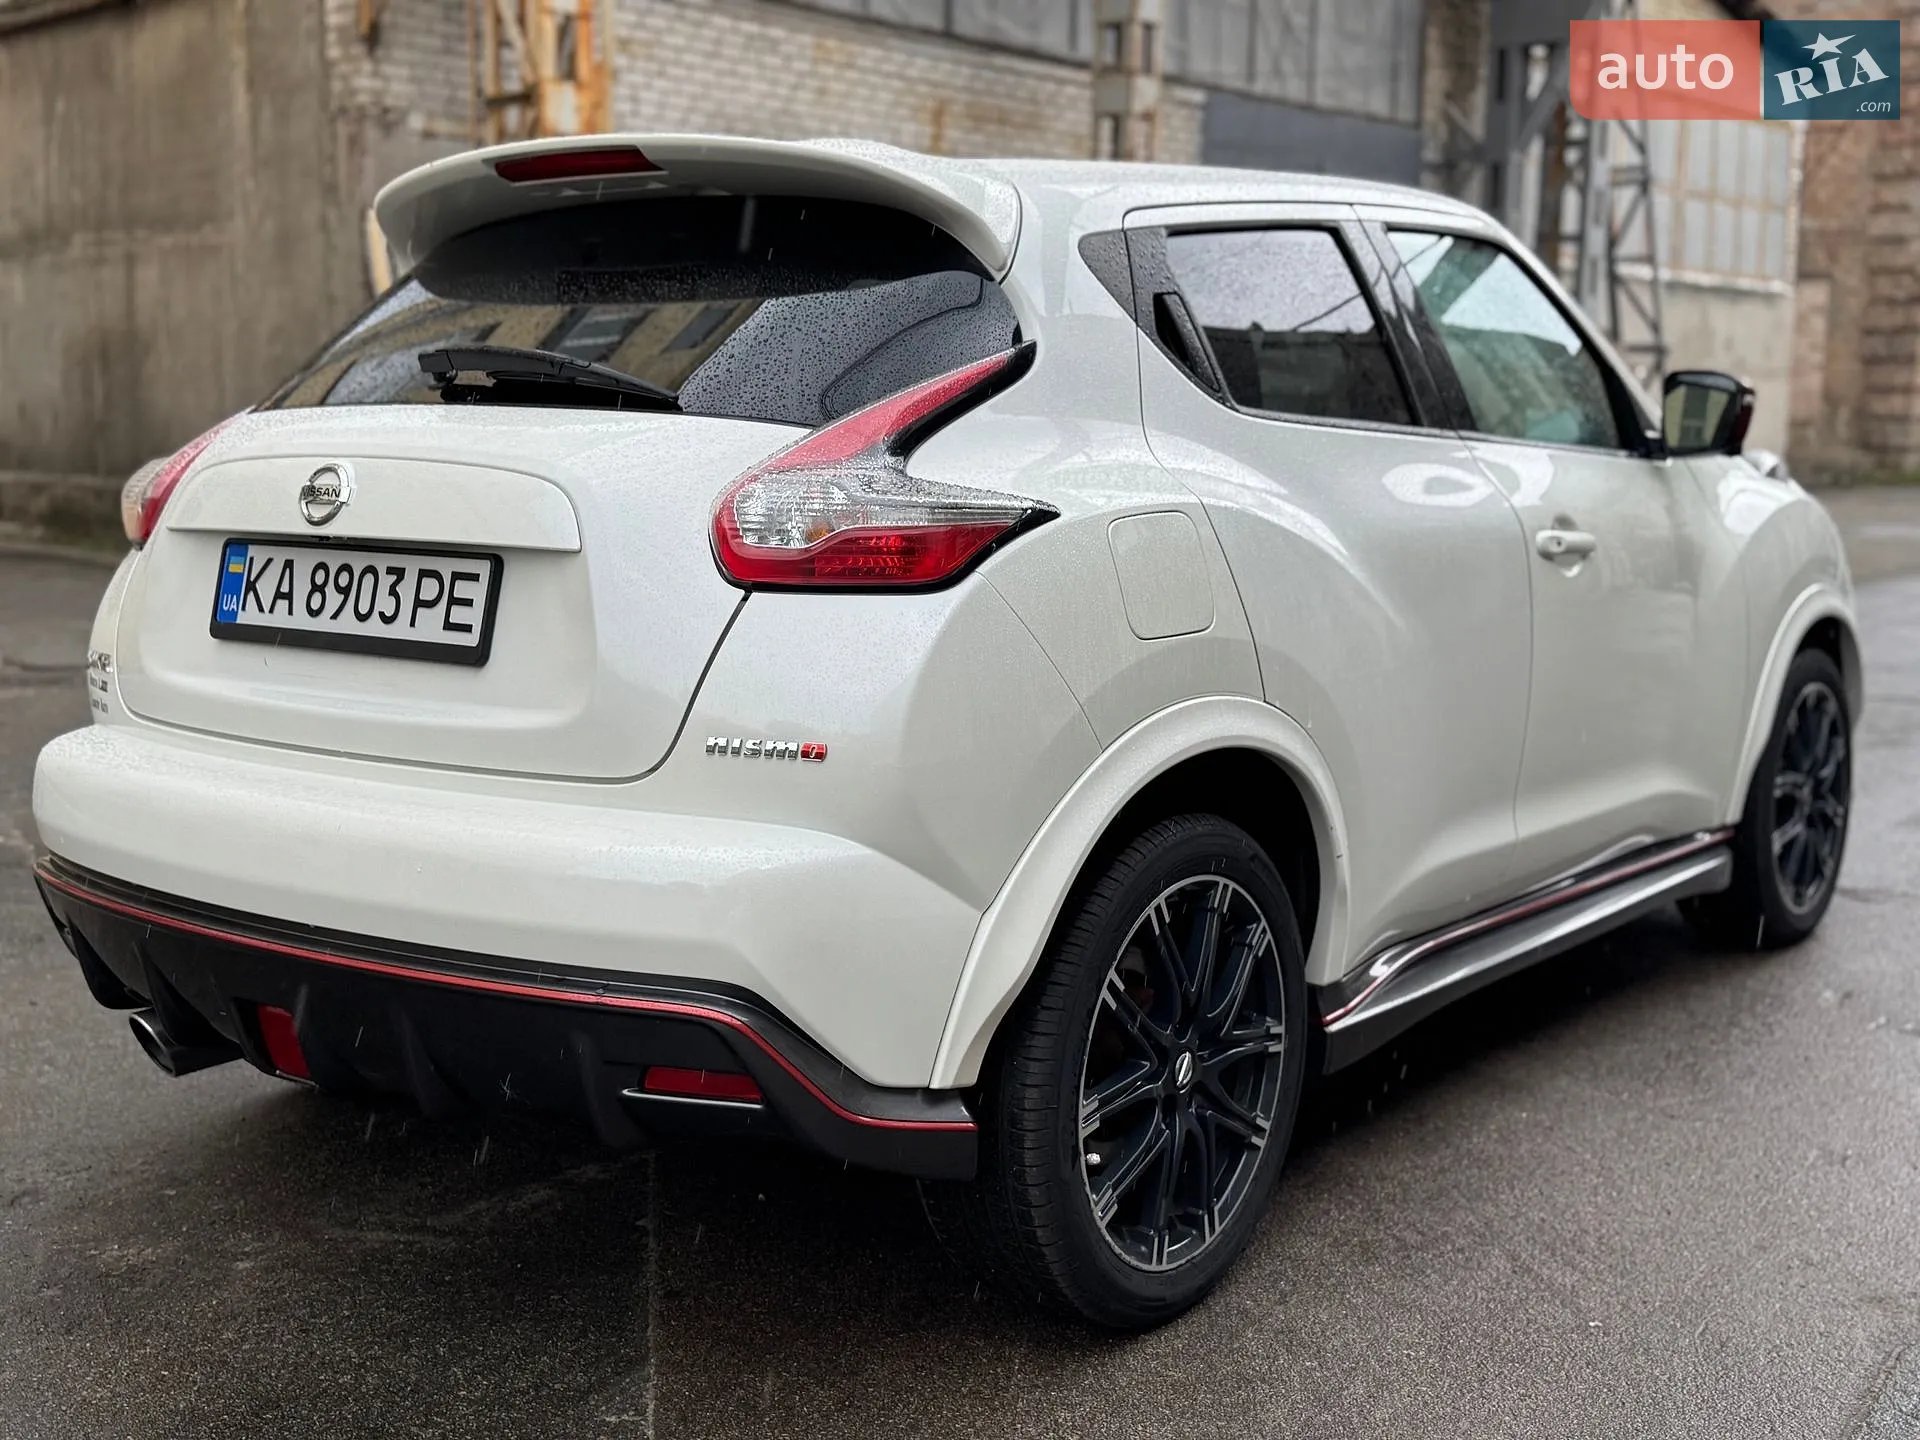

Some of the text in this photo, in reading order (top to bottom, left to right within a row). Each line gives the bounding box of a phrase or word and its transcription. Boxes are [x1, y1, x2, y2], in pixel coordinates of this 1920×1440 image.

[302, 486, 341, 498] NISSAN
[223, 593, 238, 612] UA
[241, 556, 480, 633] KA 8903 PE
